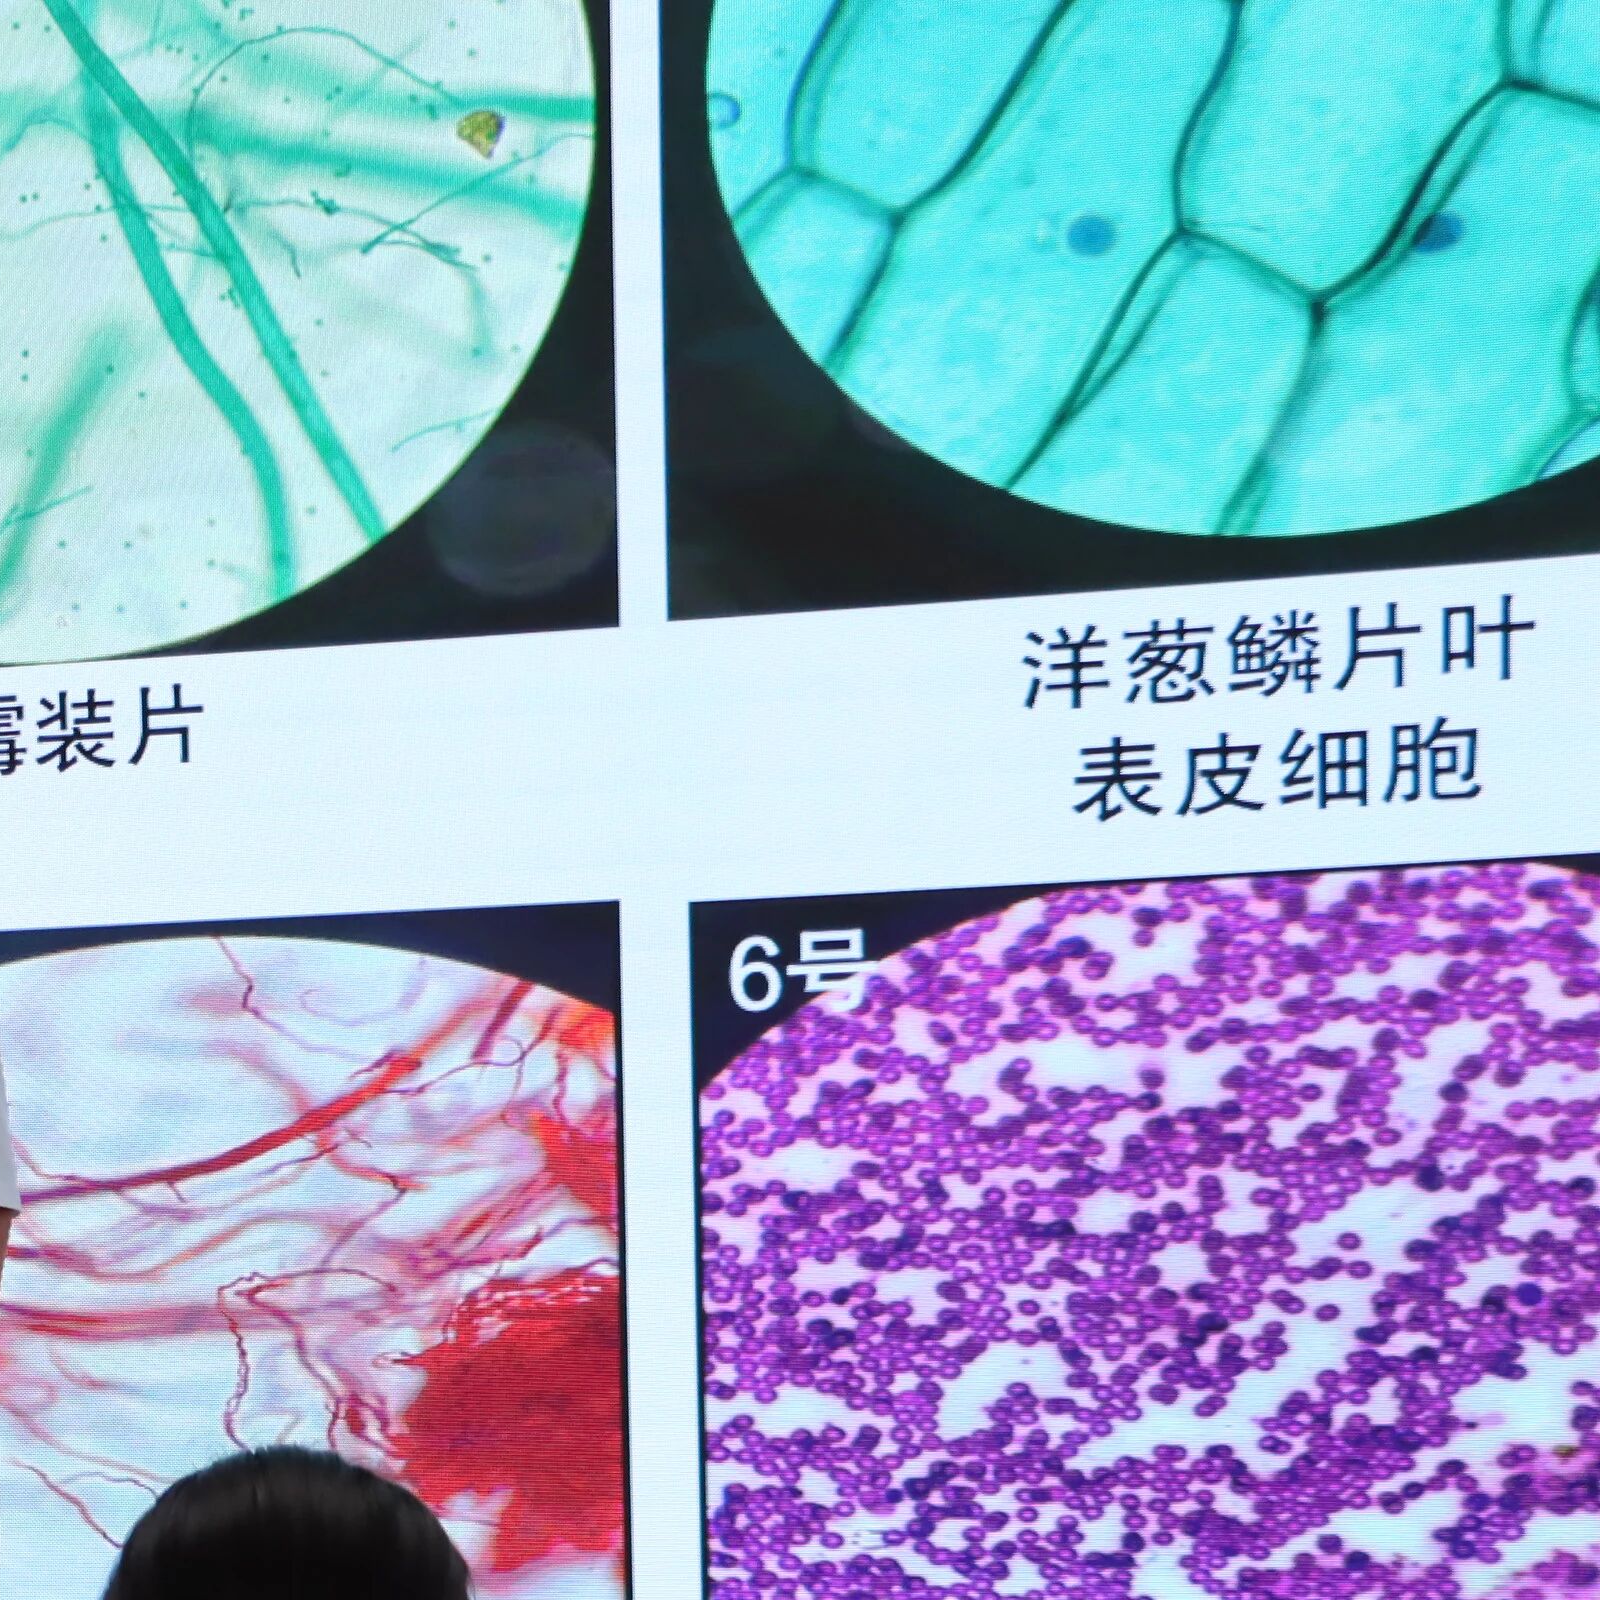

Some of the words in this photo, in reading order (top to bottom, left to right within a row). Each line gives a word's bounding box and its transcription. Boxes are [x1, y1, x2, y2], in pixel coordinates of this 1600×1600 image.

[1022, 594, 1535, 709] 洋葱鳞片叶
[1073, 717, 1483, 822] 表皮细胞
[727, 927, 881, 1013] 6号
